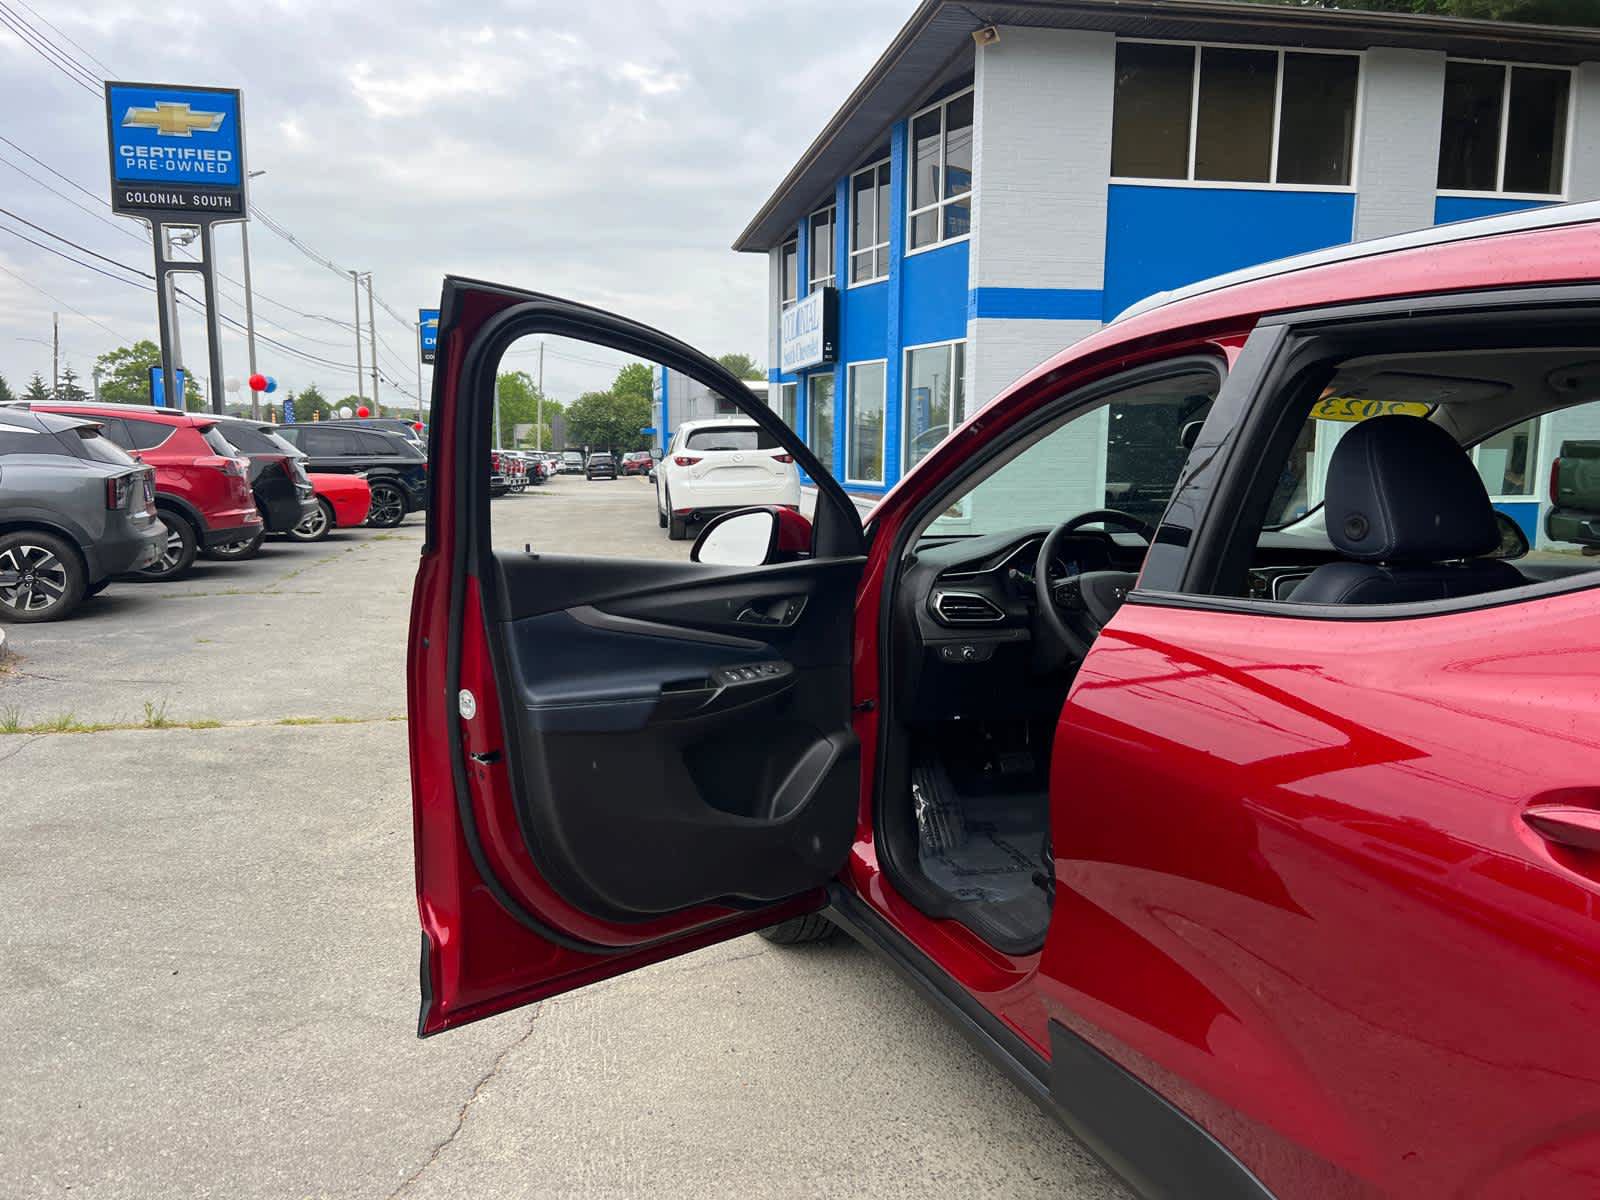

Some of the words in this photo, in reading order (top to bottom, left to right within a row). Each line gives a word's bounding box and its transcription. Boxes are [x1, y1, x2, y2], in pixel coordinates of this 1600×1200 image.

[120, 145, 232, 161] CERTIFIED
[126, 158, 228, 173] PRE-OWNED
[126, 192, 186, 205] COLONIAL
[193, 195, 232, 207] SOUTH
